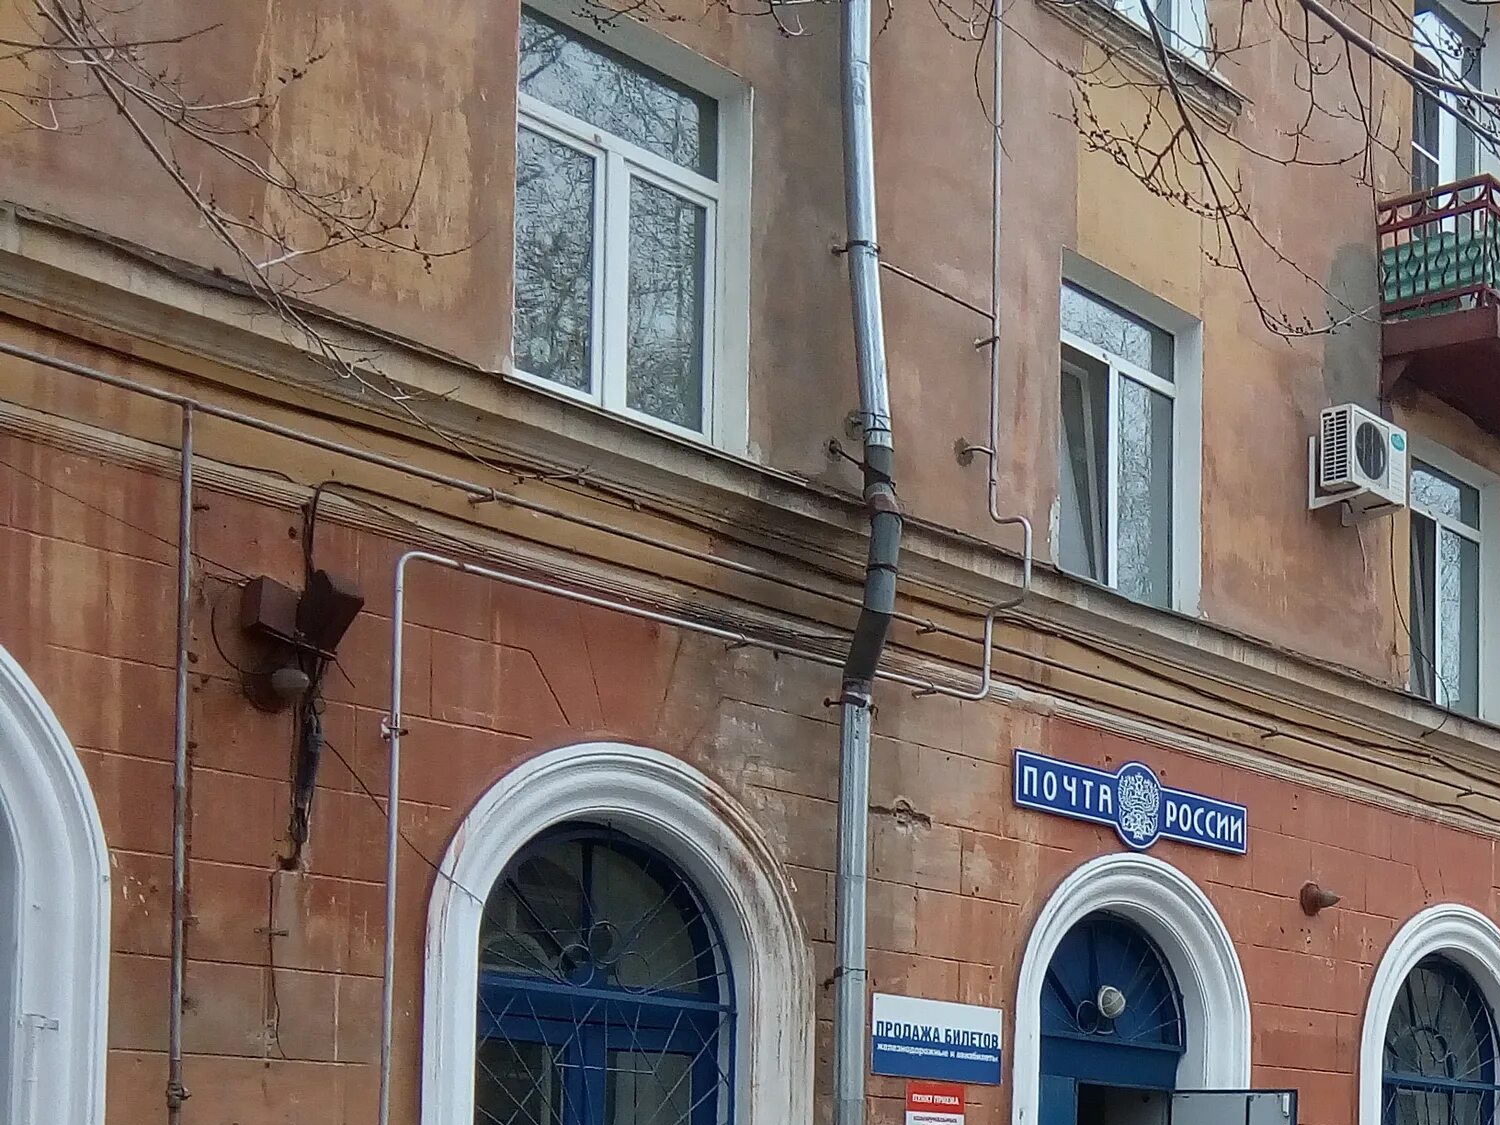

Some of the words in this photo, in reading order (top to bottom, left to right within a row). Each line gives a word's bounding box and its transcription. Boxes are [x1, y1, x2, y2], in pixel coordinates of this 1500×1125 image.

[1023, 765, 1113, 815] ПОЧТА
[1165, 799, 1243, 844] РОССИИ
[876, 1019, 940, 1042] ПРОДАЖА
[944, 1028, 999, 1050] БИЛЕТОВ
